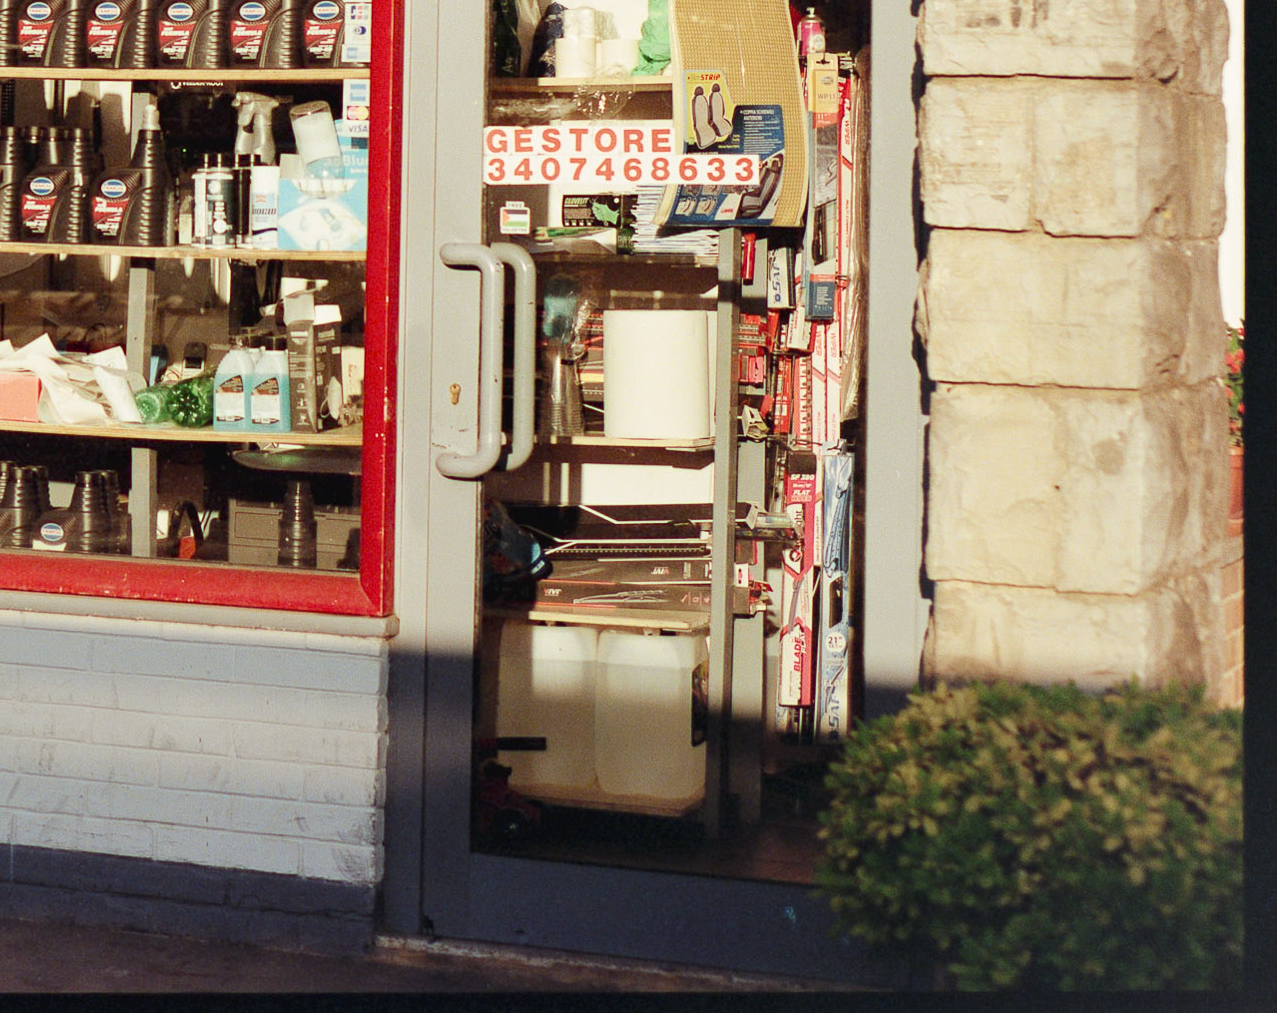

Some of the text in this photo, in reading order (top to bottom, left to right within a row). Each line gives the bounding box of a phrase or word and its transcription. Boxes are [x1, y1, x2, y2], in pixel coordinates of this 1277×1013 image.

[487, 128, 672, 153] GESTORE
[488, 158, 754, 182] 3407468633
[794, 636, 802, 672] BLADE
